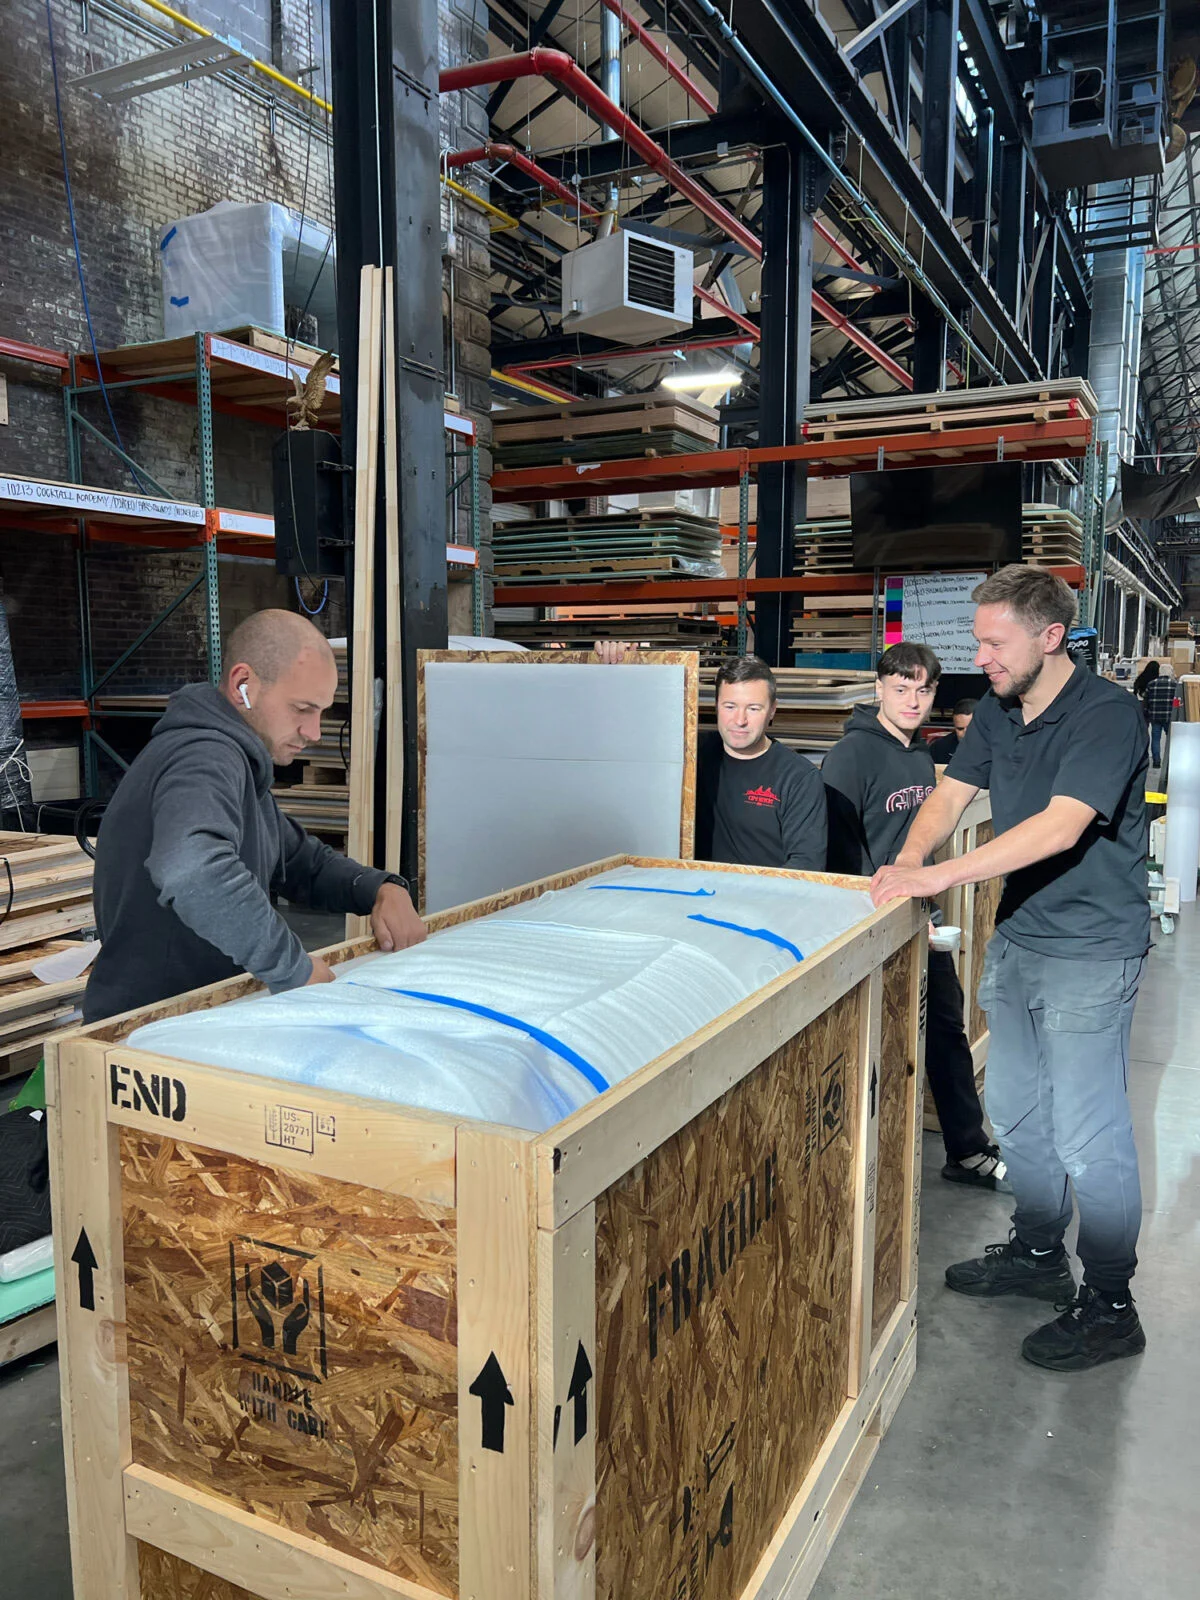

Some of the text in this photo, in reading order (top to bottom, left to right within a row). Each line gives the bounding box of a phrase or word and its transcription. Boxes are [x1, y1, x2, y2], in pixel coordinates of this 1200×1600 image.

[1067, 639, 1089, 650] EXPO
[110, 1064, 187, 1122] END
[283, 1123, 310, 1137] 20771
[284, 1135, 296, 1146] HT
[648, 1150, 777, 1361] FRAGILE
[252, 1371, 313, 1411] HANDLE
[238, 1391, 328, 1440] WITH CARE
